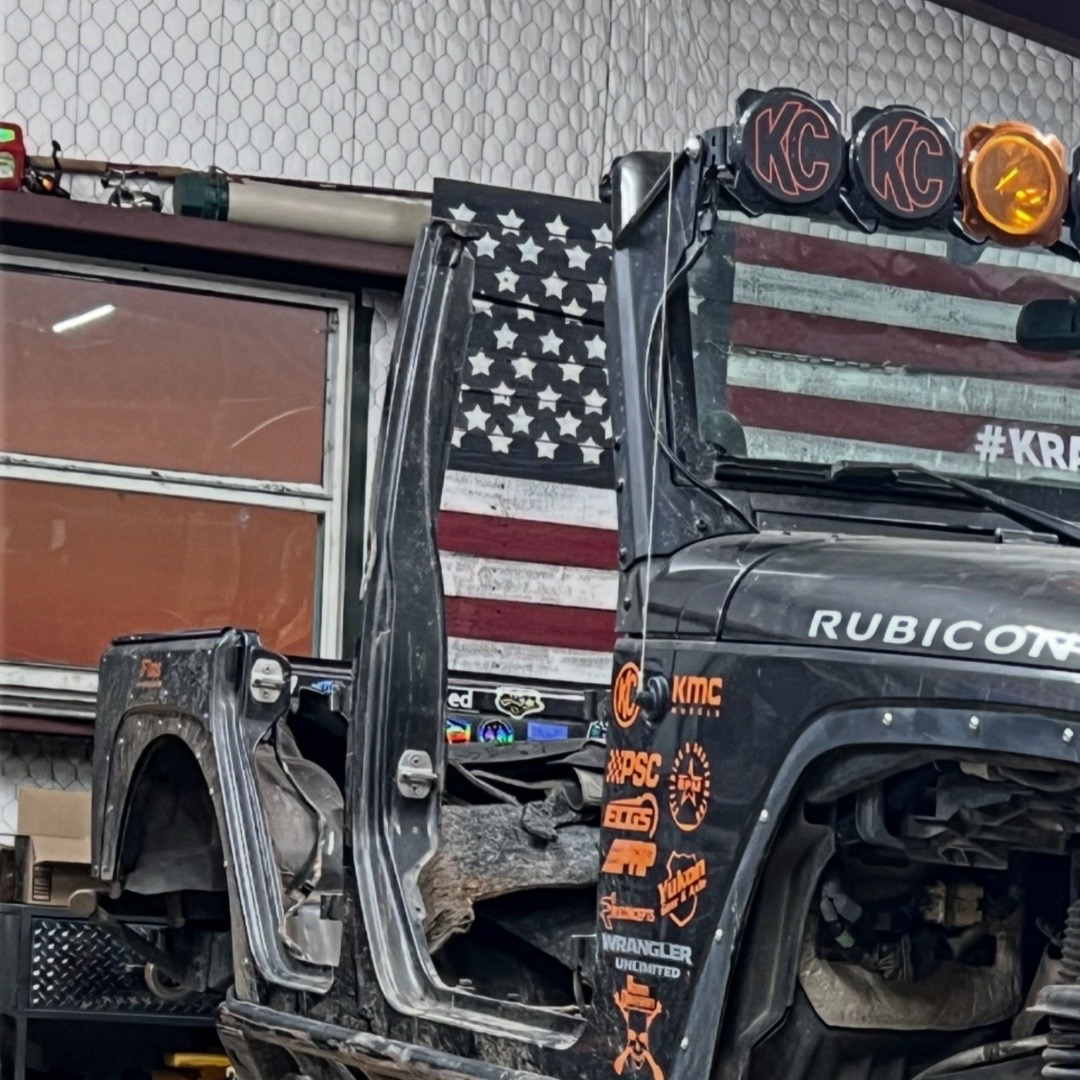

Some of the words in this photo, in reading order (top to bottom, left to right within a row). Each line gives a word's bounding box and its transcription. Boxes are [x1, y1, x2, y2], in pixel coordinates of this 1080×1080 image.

[755, 101, 830, 196] KC
[870, 118, 944, 213] KC
[808, 609, 1077, 662] RUBICON
[671, 675, 723, 706] KMC
[619, 749, 662, 788] PSC
[602, 932, 693, 966] WRANGLER
[615, 957, 681, 979] UNLIMITED
